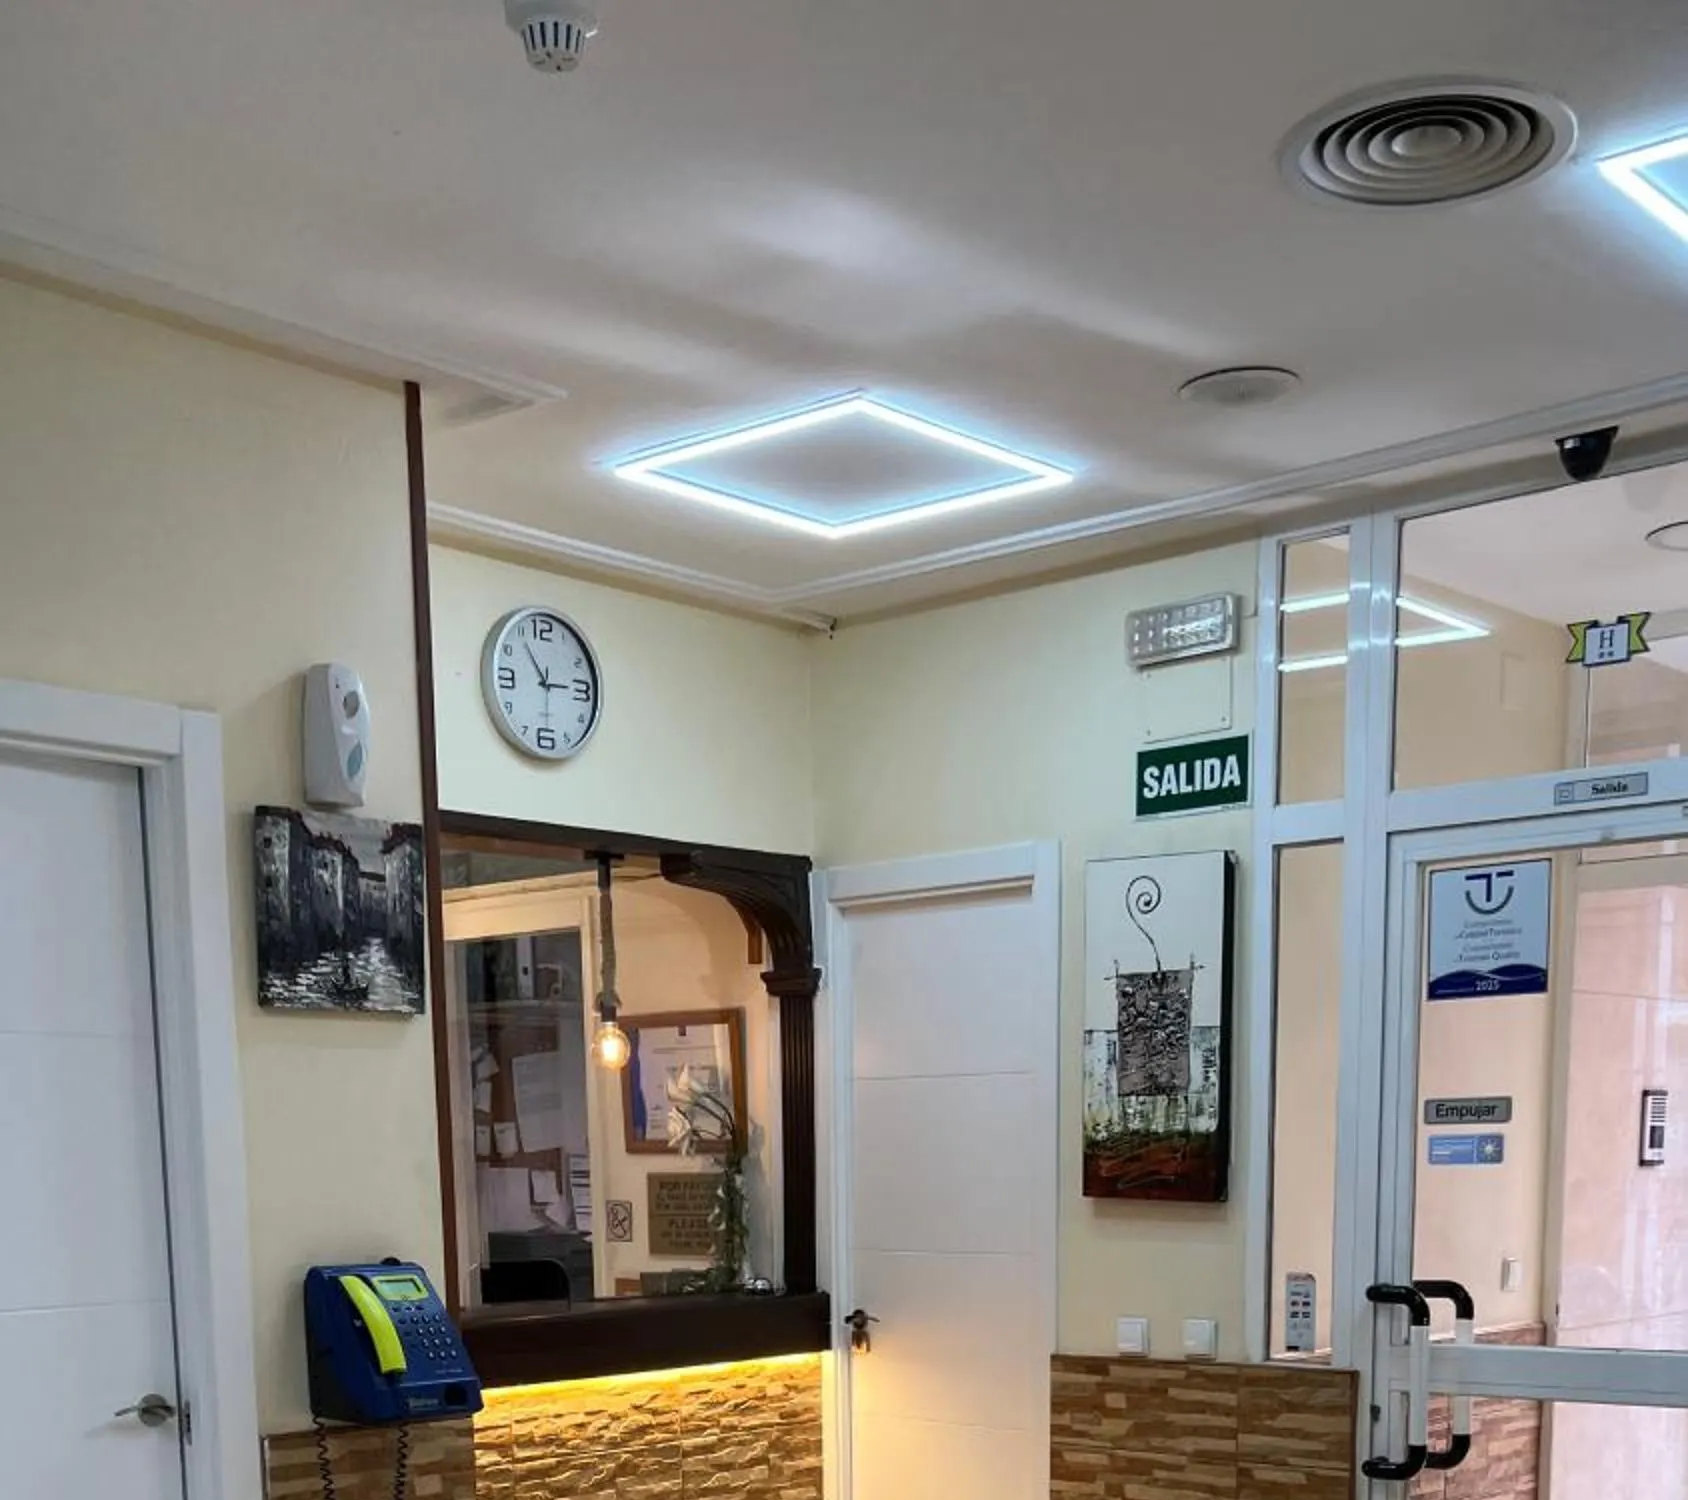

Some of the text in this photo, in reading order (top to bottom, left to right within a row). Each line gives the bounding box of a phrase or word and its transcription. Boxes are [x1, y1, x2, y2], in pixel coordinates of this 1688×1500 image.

[531, 619, 553, 641] 12
[1600, 629, 1615, 648] H
[573, 657, 582, 669] 2
[498, 667, 516, 689] 9
[572, 679, 590, 702] 3
[521, 725, 529, 737] 7
[537, 727, 555, 750] 6
[1143, 754, 1241, 799] SALIDA
[1435, 1103, 1498, 1120] Empujar
